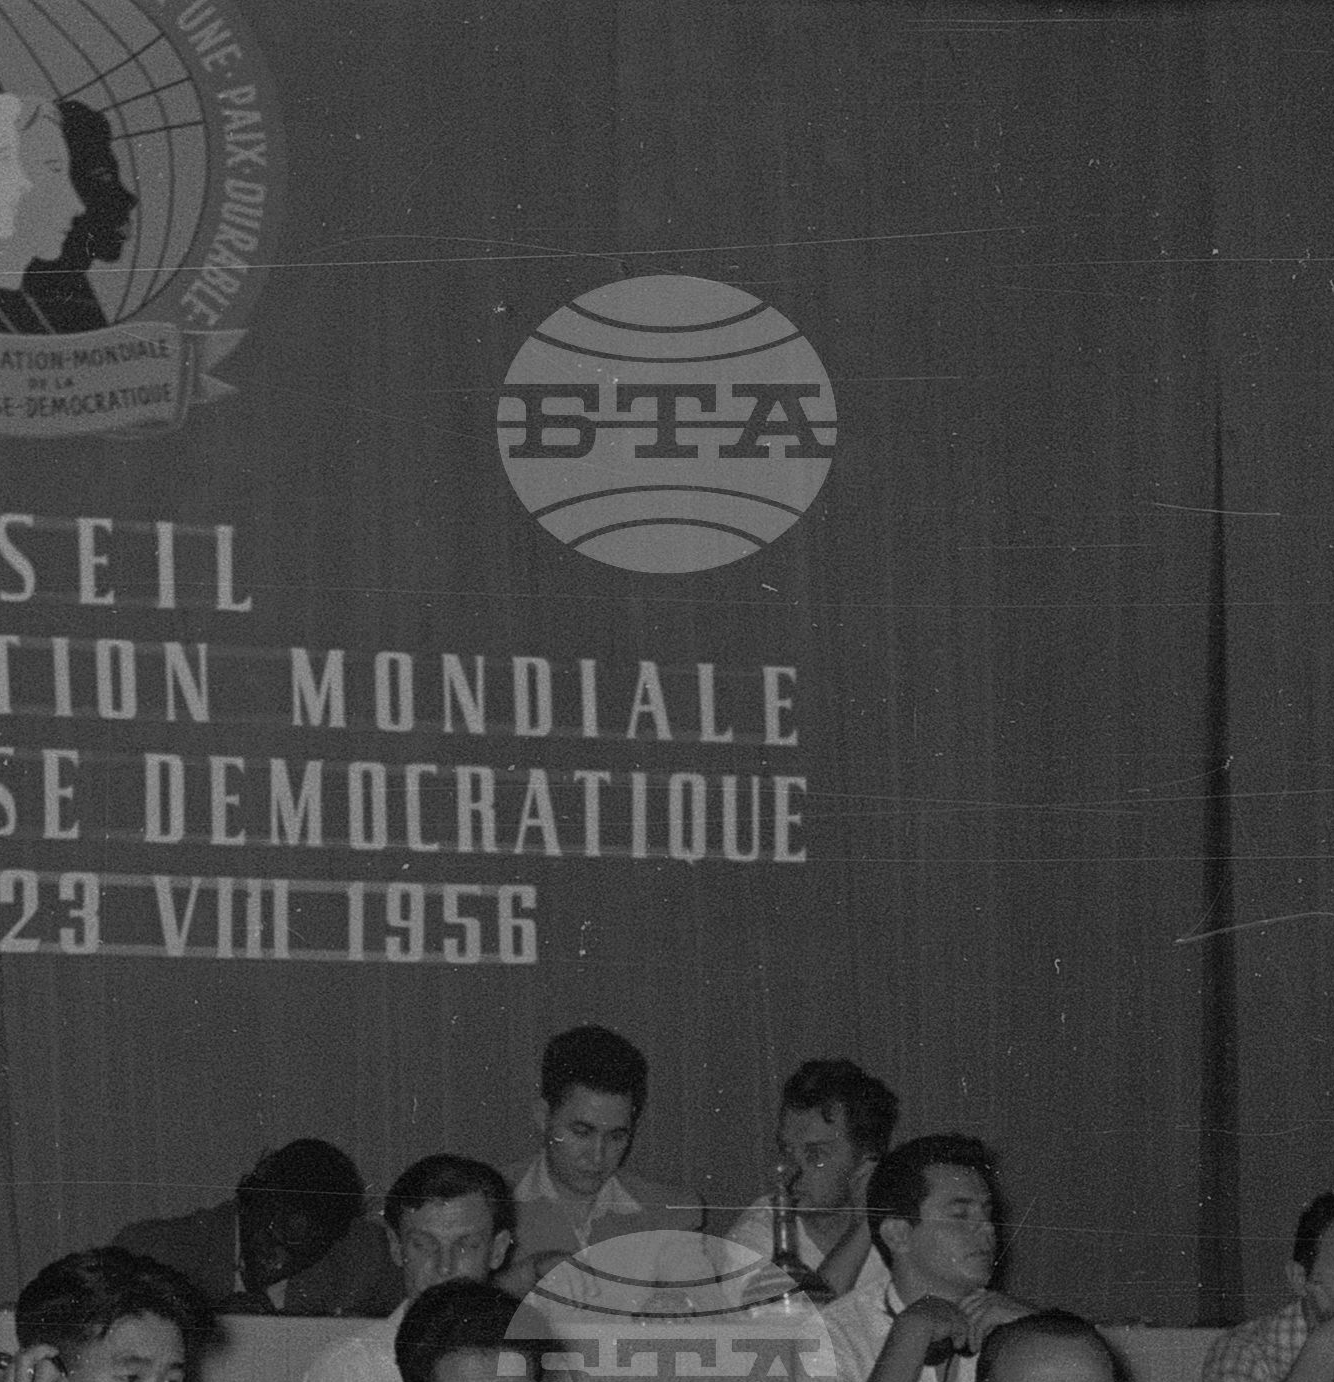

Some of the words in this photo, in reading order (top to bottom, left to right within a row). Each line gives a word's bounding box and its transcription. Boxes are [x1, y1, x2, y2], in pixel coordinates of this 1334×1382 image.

[218, 84, 267, 167] PAIX
[180, 178, 267, 327] DURABLE
[290, 646, 800, 746] MONDIALE
[144, 753, 808, 864] DEMOCRATIQUE
[348, 883, 538, 965] 1956
